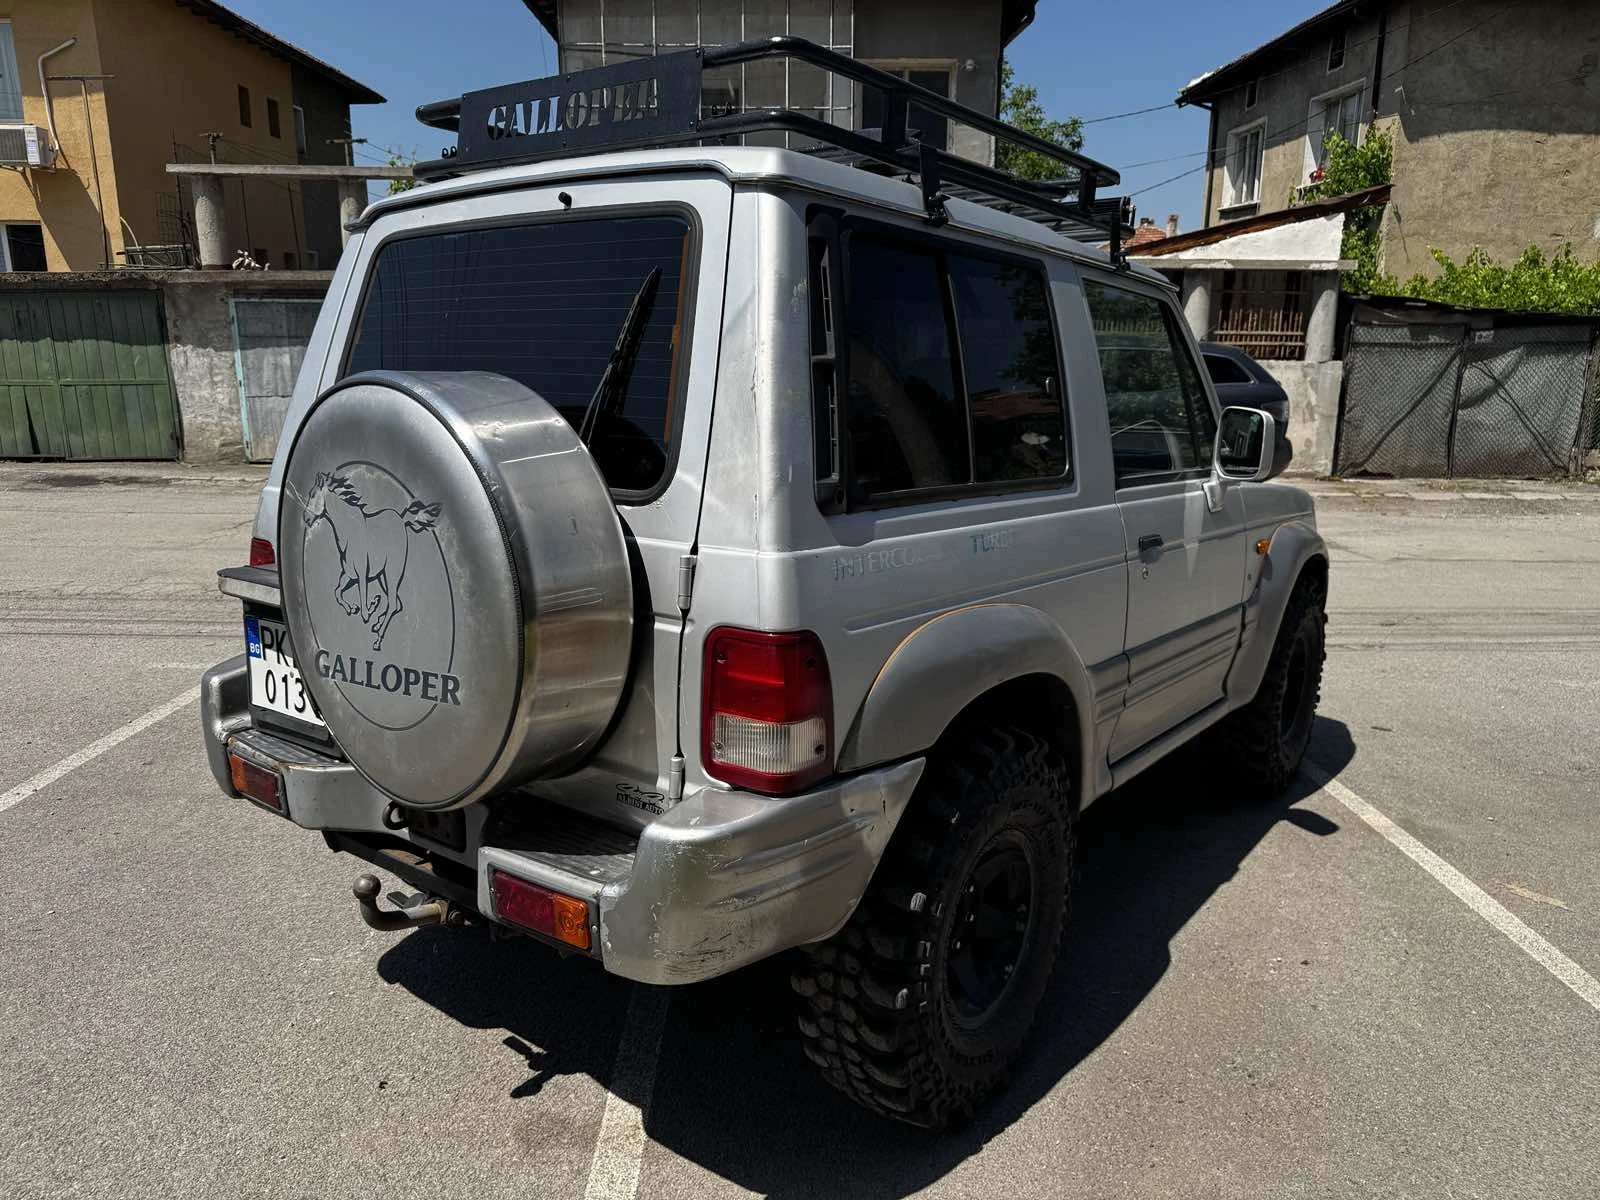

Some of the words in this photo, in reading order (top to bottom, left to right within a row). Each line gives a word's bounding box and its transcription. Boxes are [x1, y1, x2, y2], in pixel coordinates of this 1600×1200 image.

[249, 642, 260, 654] BG
[260, 625, 297, 668] PK
[314, 649, 461, 706] GALLOPER
